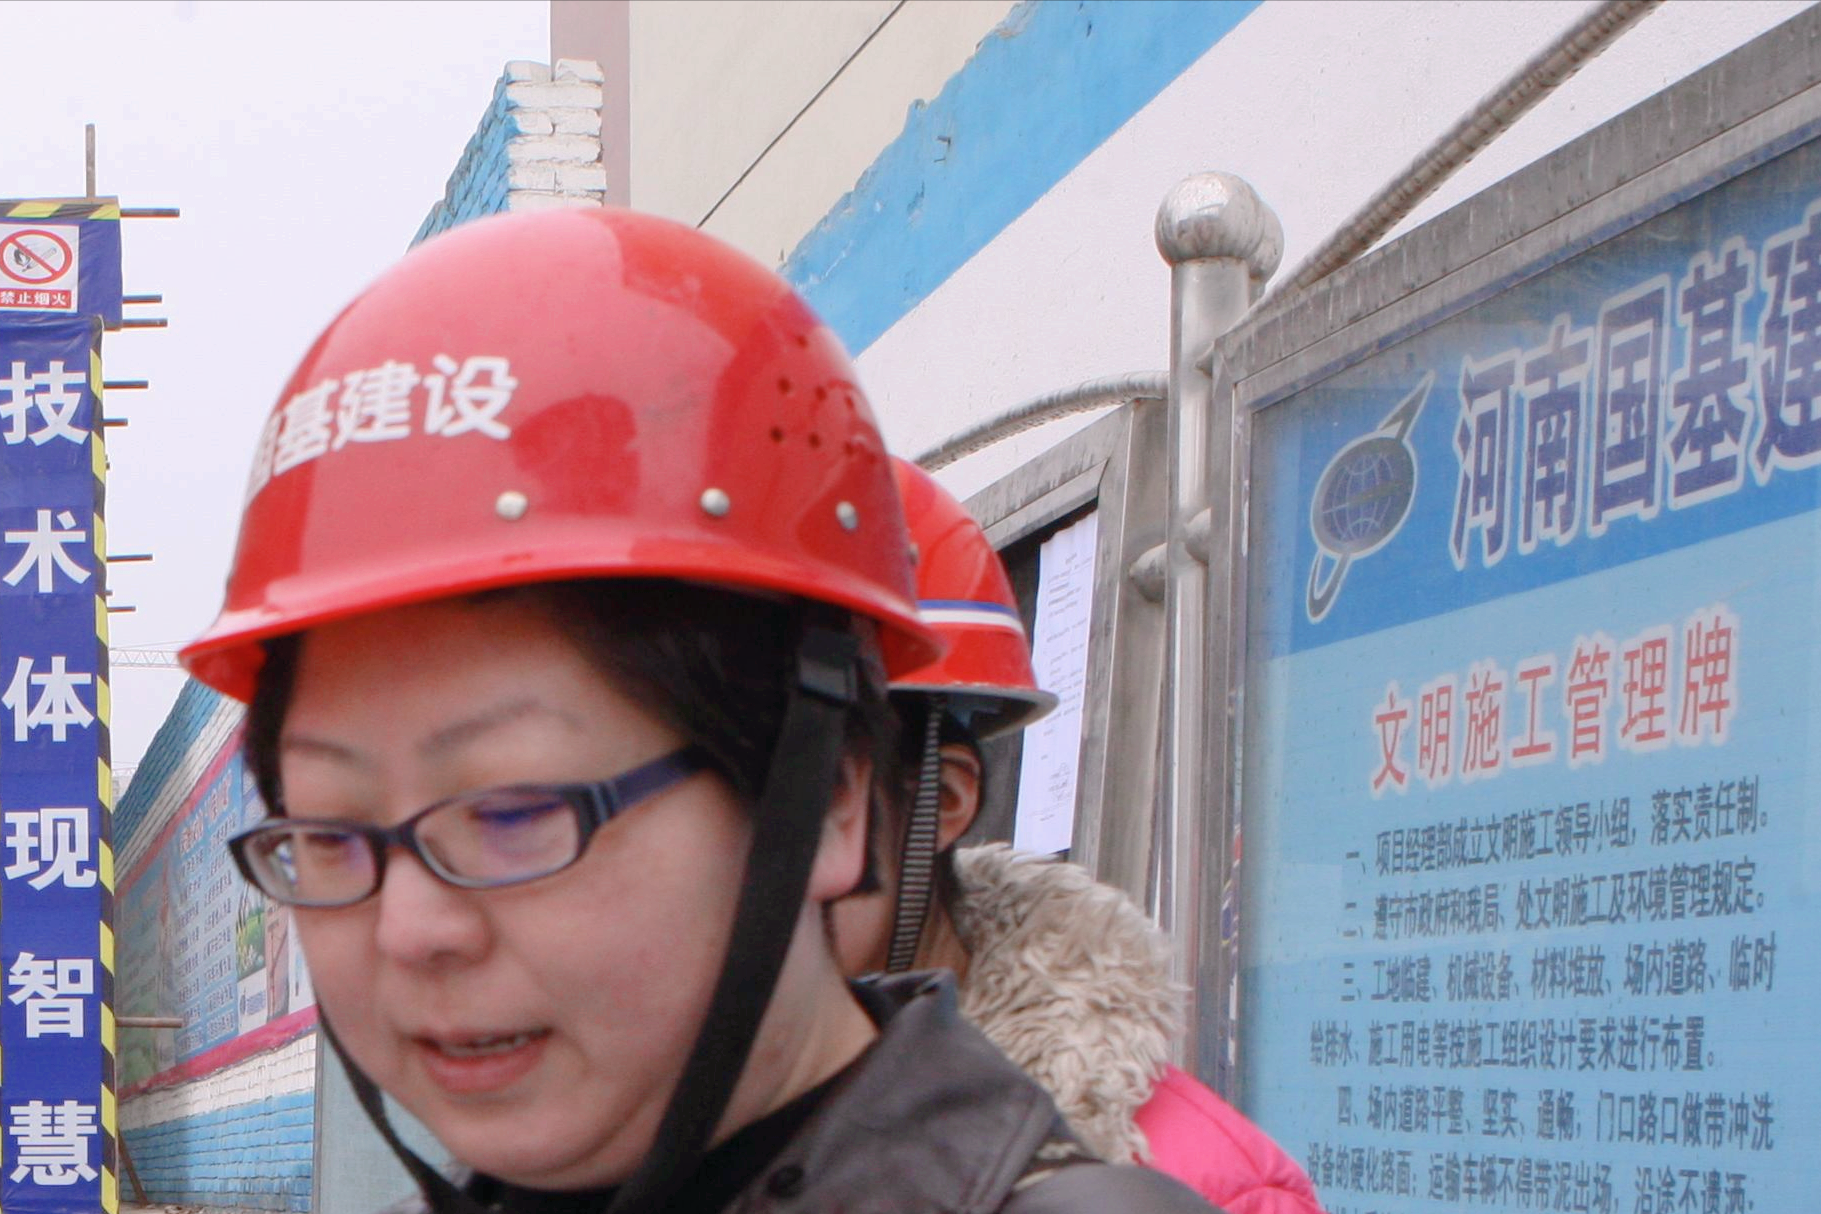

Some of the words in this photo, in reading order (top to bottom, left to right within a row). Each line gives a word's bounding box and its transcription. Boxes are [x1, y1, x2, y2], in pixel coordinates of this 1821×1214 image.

[1373, 614, 1732, 790] 文明施工管理牌
